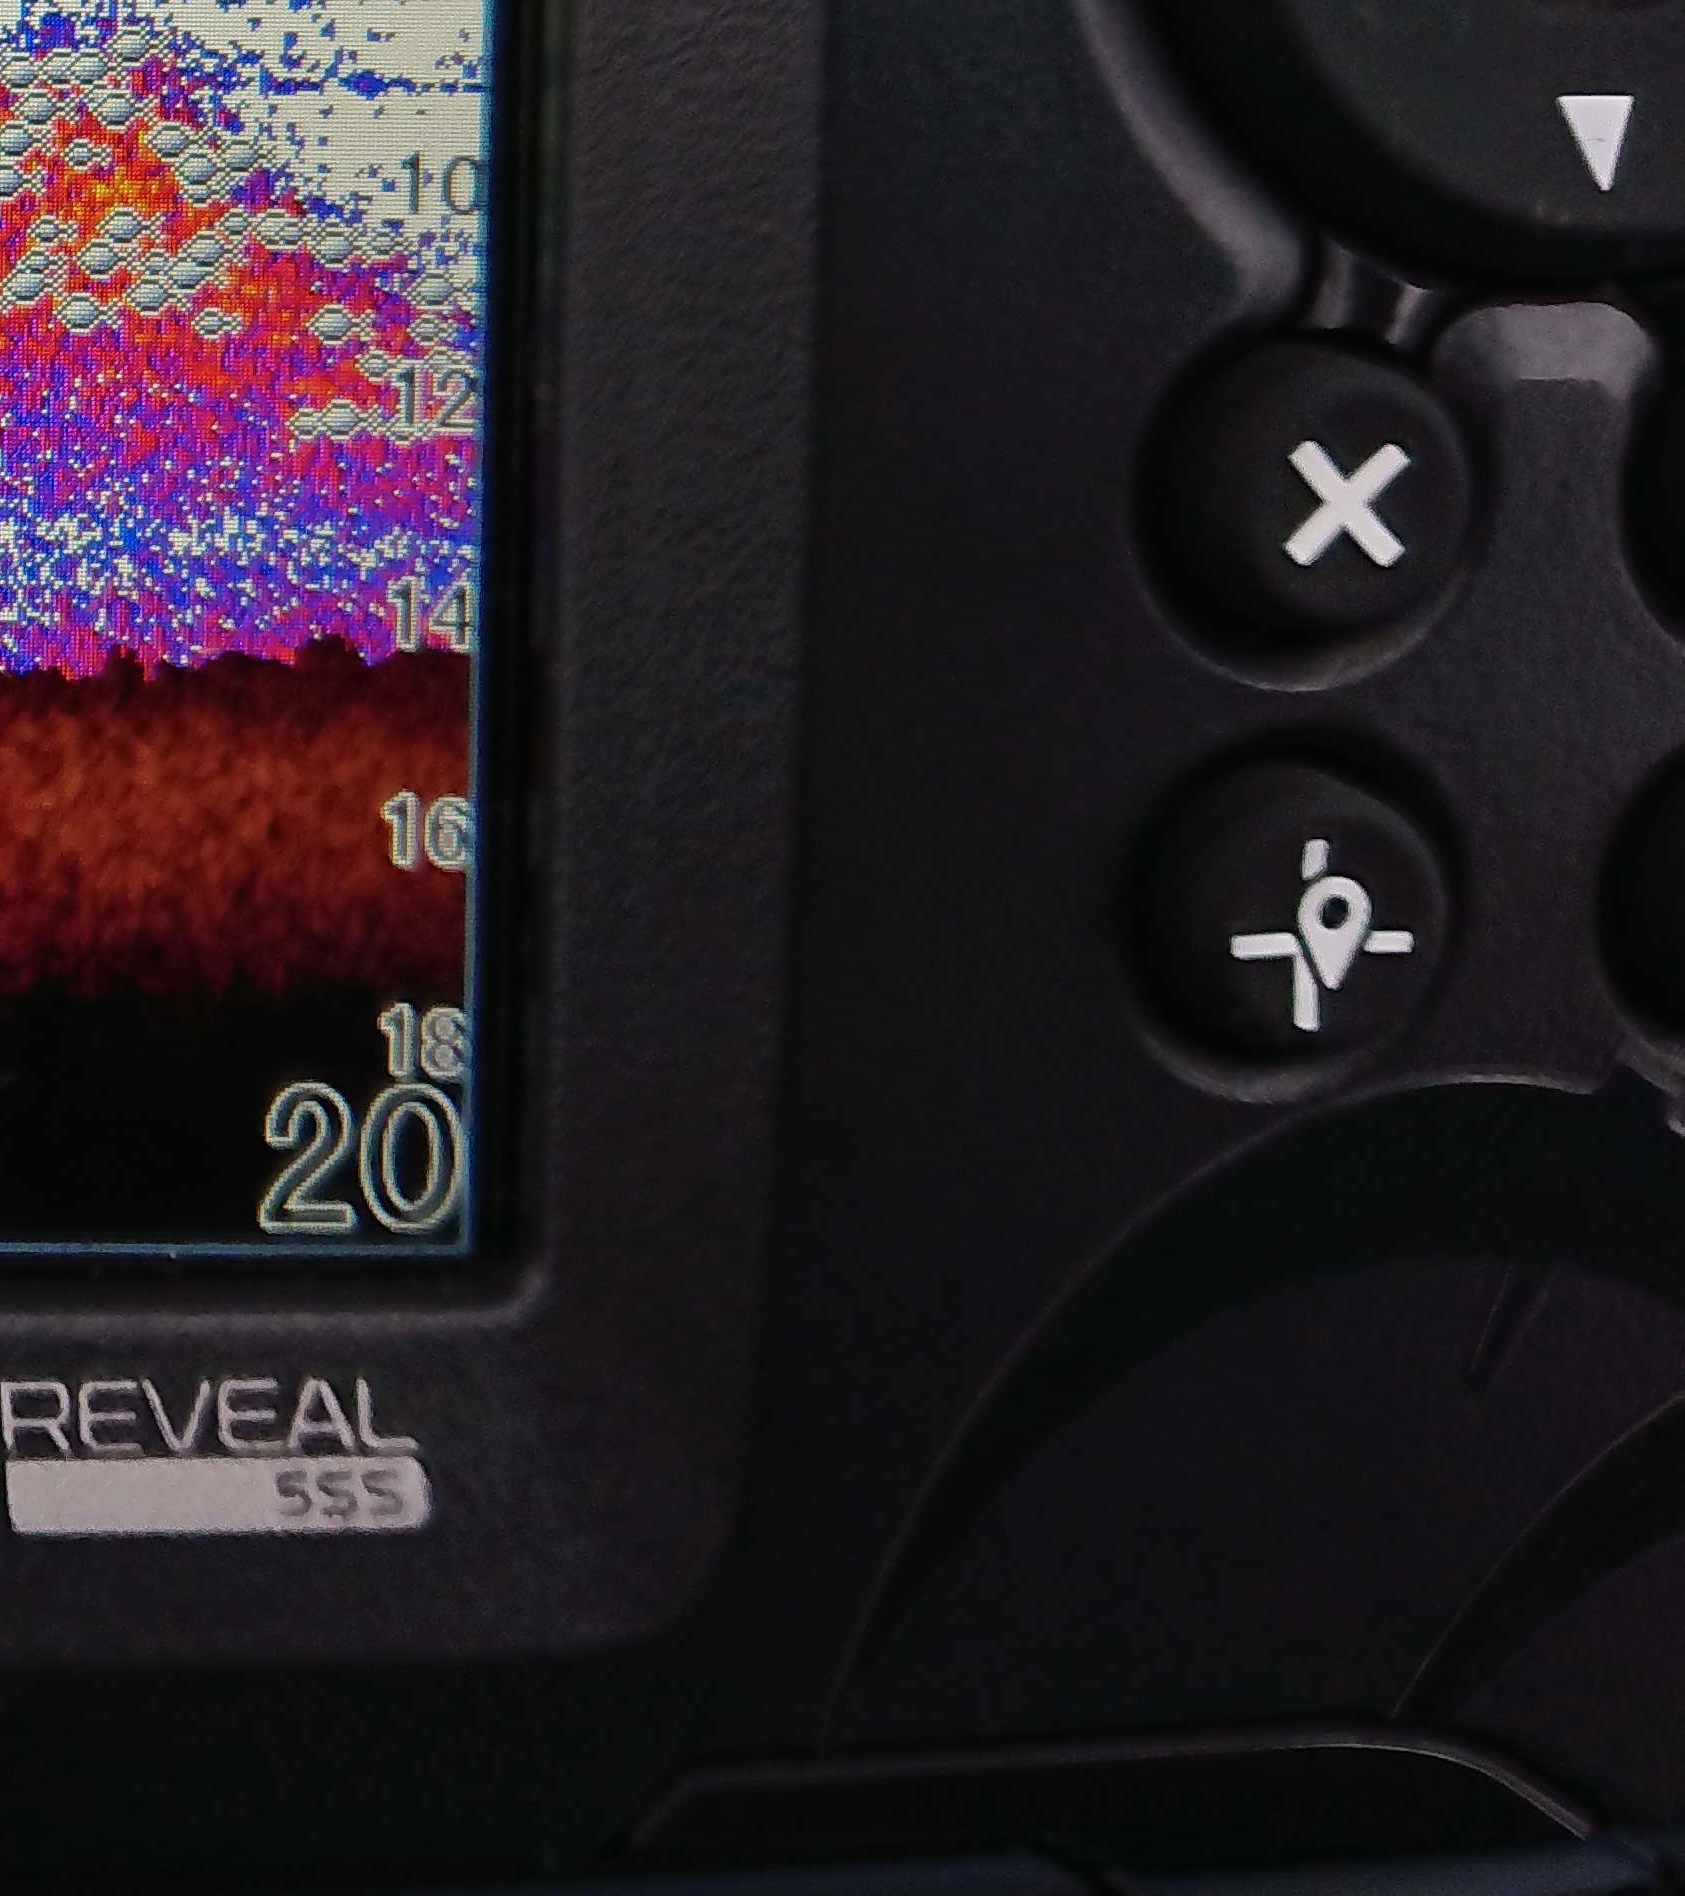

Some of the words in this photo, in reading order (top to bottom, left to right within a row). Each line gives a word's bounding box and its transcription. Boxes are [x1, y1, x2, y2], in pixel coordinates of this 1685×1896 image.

[399, 152, 486, 216] 10
[393, 364, 480, 432] 12
[388, 576, 472, 652] 14
[379, 789, 475, 872] 16
[376, 1001, 470, 1081] 18
[256, 1078, 471, 1236] 20
